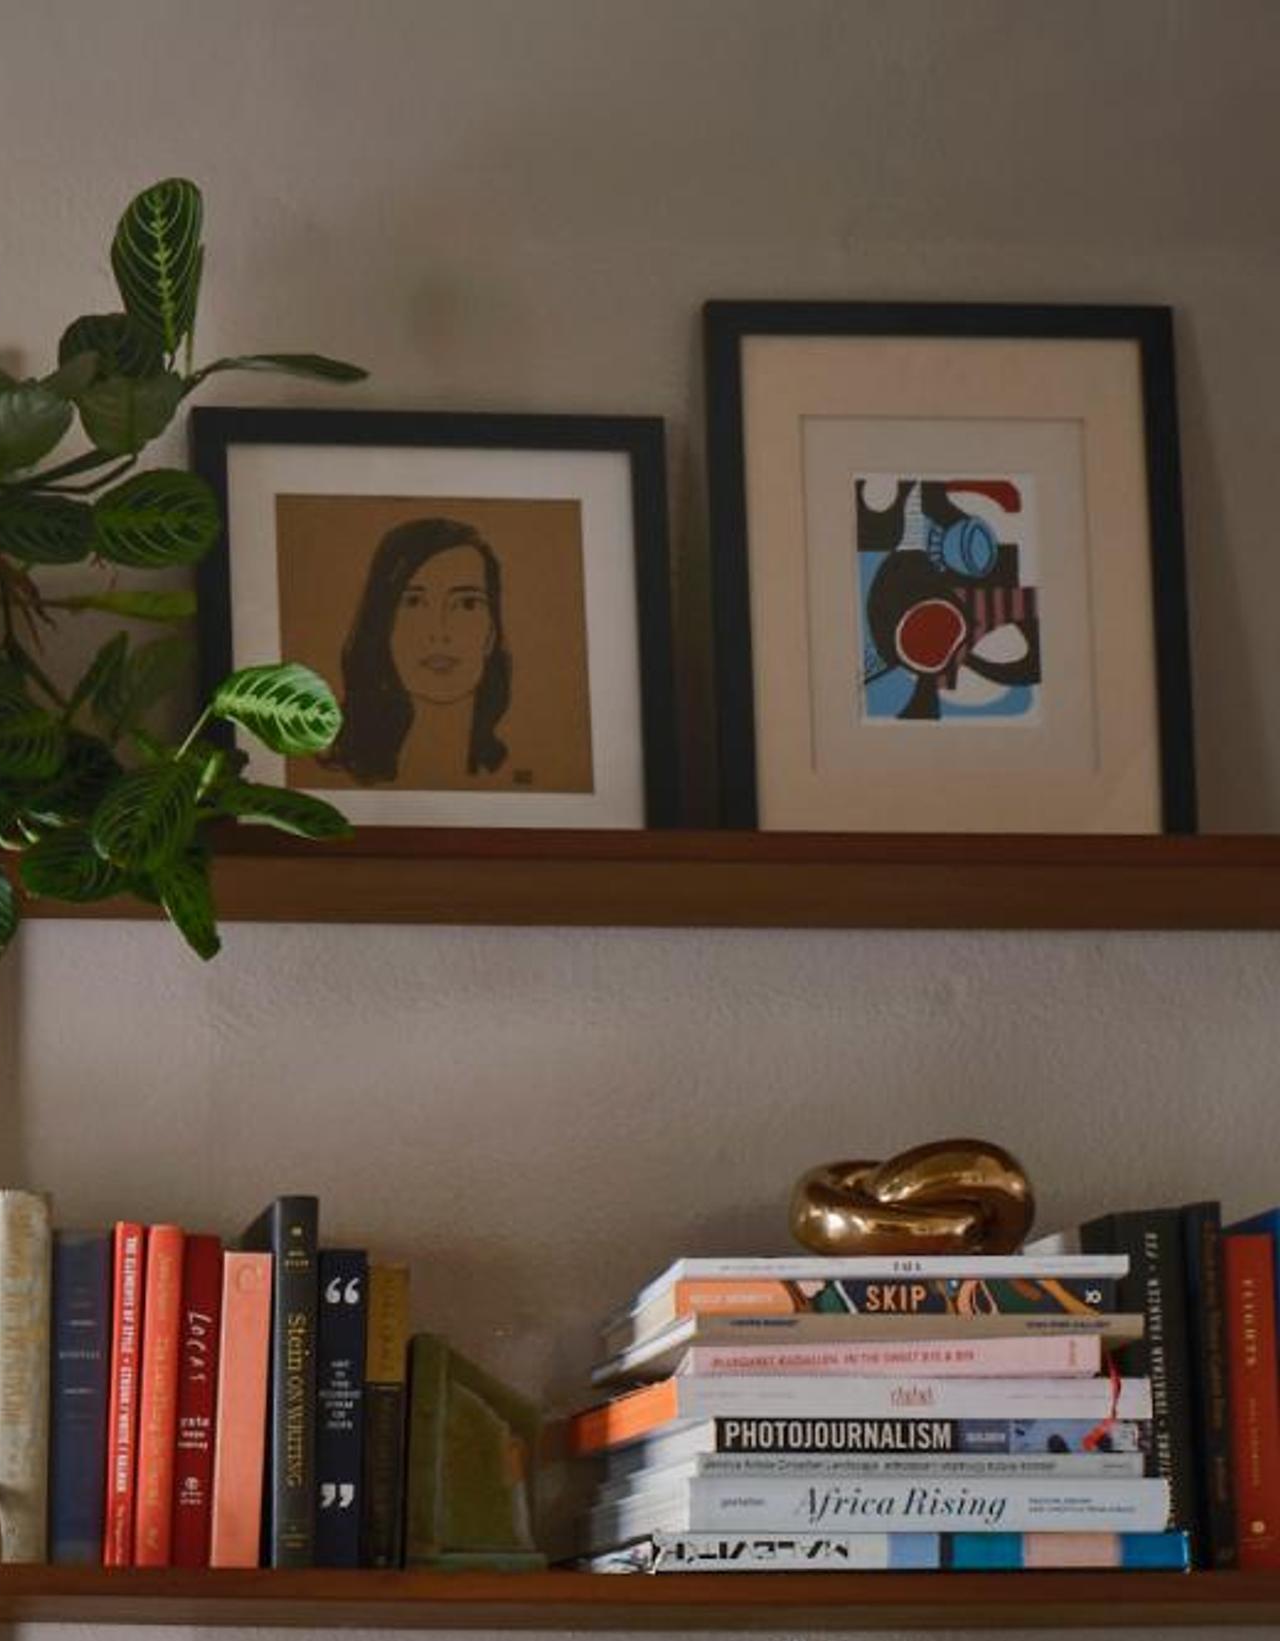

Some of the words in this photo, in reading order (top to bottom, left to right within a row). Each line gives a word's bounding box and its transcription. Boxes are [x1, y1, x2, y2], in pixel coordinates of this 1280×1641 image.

[865, 1284, 928, 1312] SKIP
[1147, 1278, 1163, 1341] FRANZEN
[288, 1312, 311, 1371] Stein
[289, 1374, 307, 1397] ON
[1151, 1345, 1168, 1415] JONATHAN
[288, 1398, 307, 1488] WRITING
[723, 1421, 953, 1450] PHOTOJOURNALISM
[795, 1486, 895, 1523] Africa
[903, 1486, 1007, 1524] Rising
